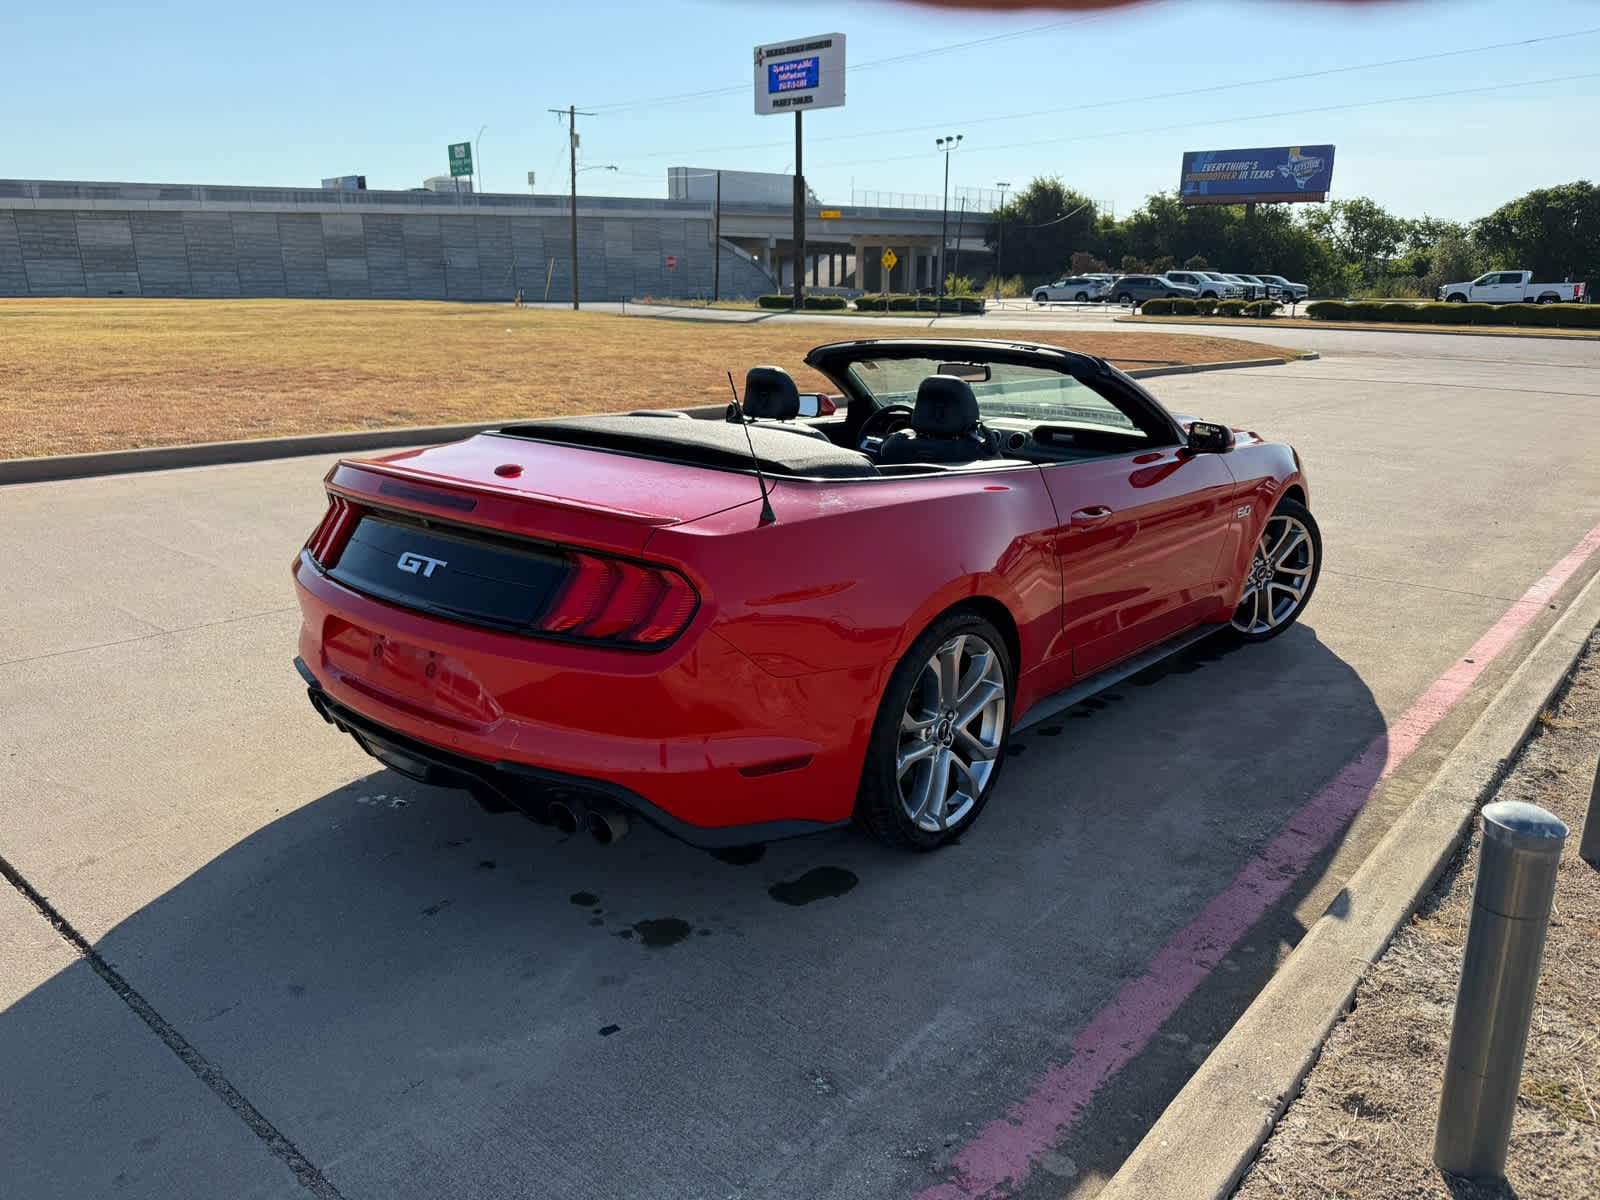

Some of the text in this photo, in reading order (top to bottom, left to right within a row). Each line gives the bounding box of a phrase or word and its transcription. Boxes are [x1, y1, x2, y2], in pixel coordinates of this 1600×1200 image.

[1202, 161, 1259, 173] EVERYTHING'S
[1250, 169, 1276, 180] TEXAS
[397, 551, 448, 578] GT
